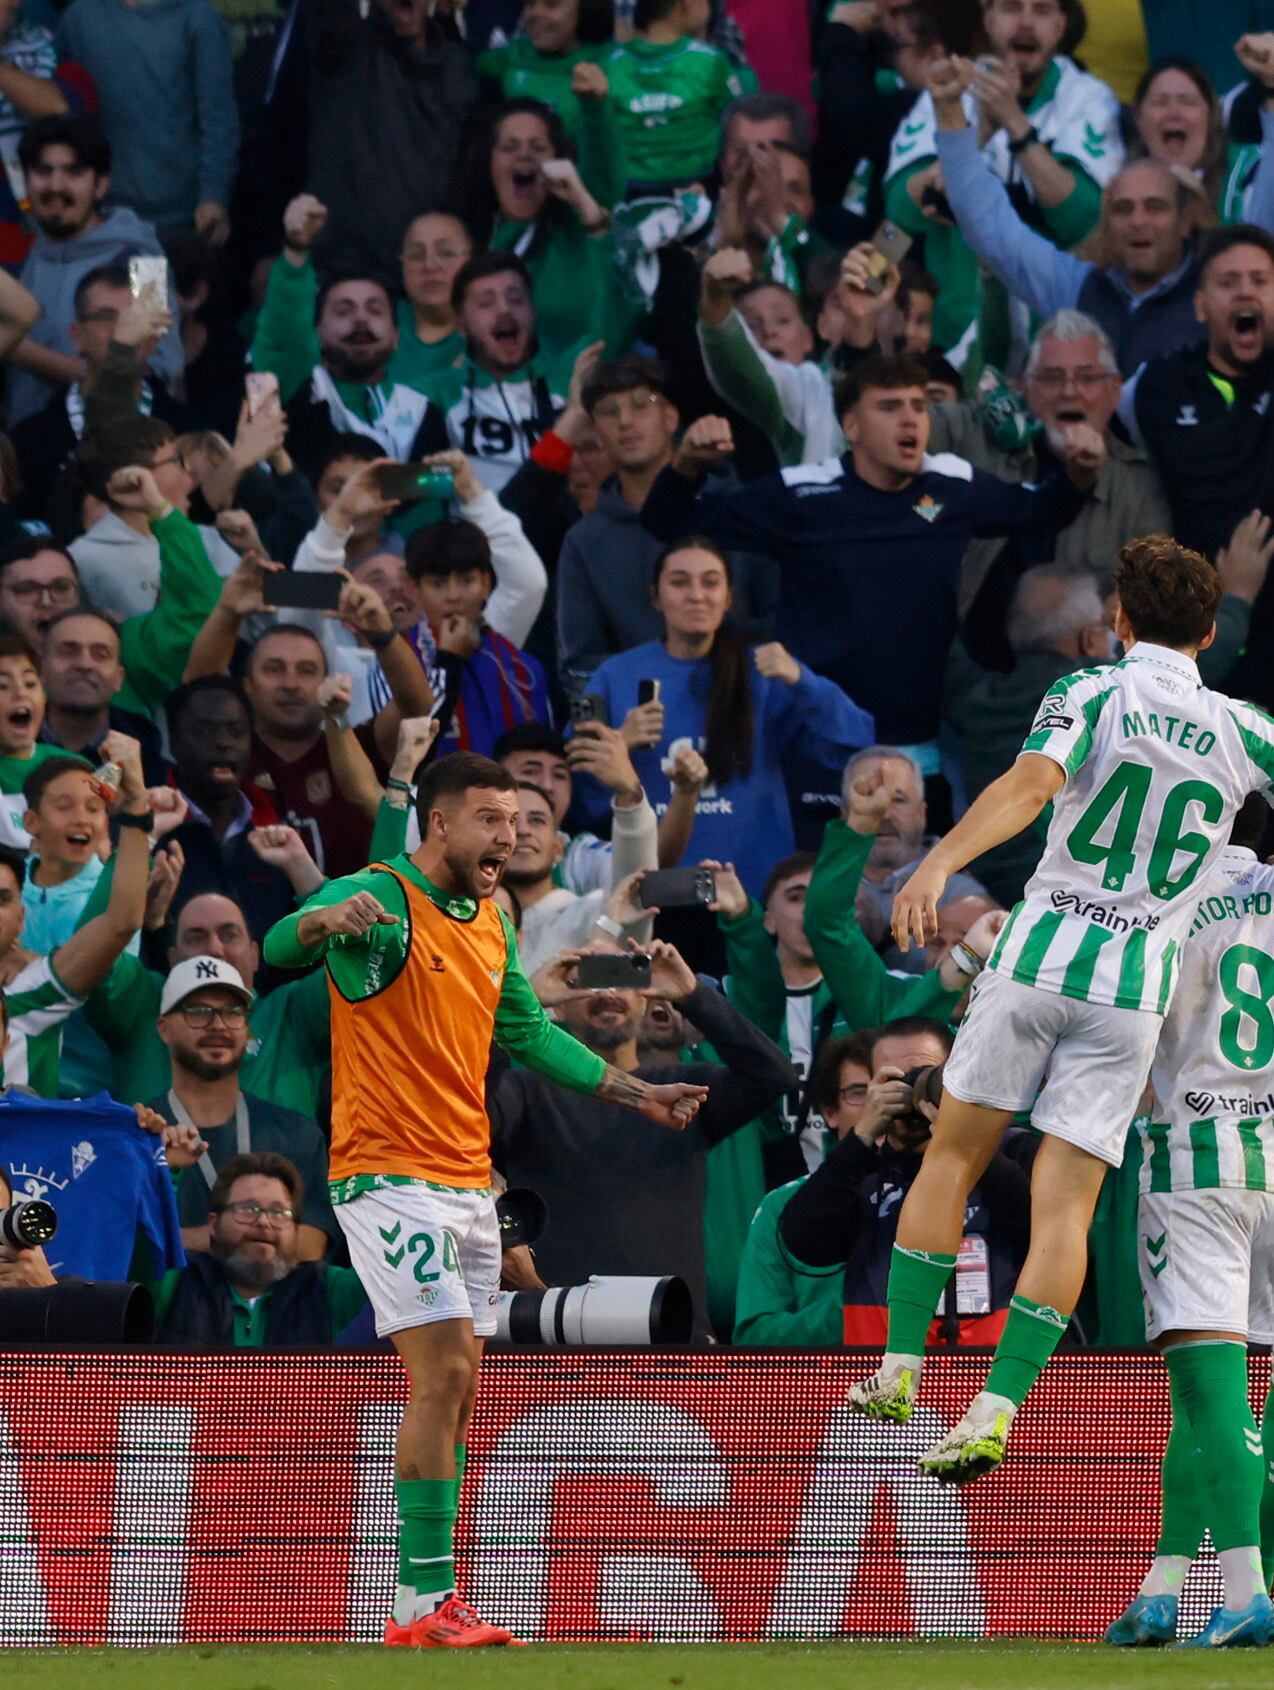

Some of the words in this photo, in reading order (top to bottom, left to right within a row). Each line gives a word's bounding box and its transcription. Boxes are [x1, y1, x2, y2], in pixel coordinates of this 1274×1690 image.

[1122, 711, 1217, 756] MATEO
[1066, 760, 1225, 900] 46
[196, 960, 218, 979] NY
